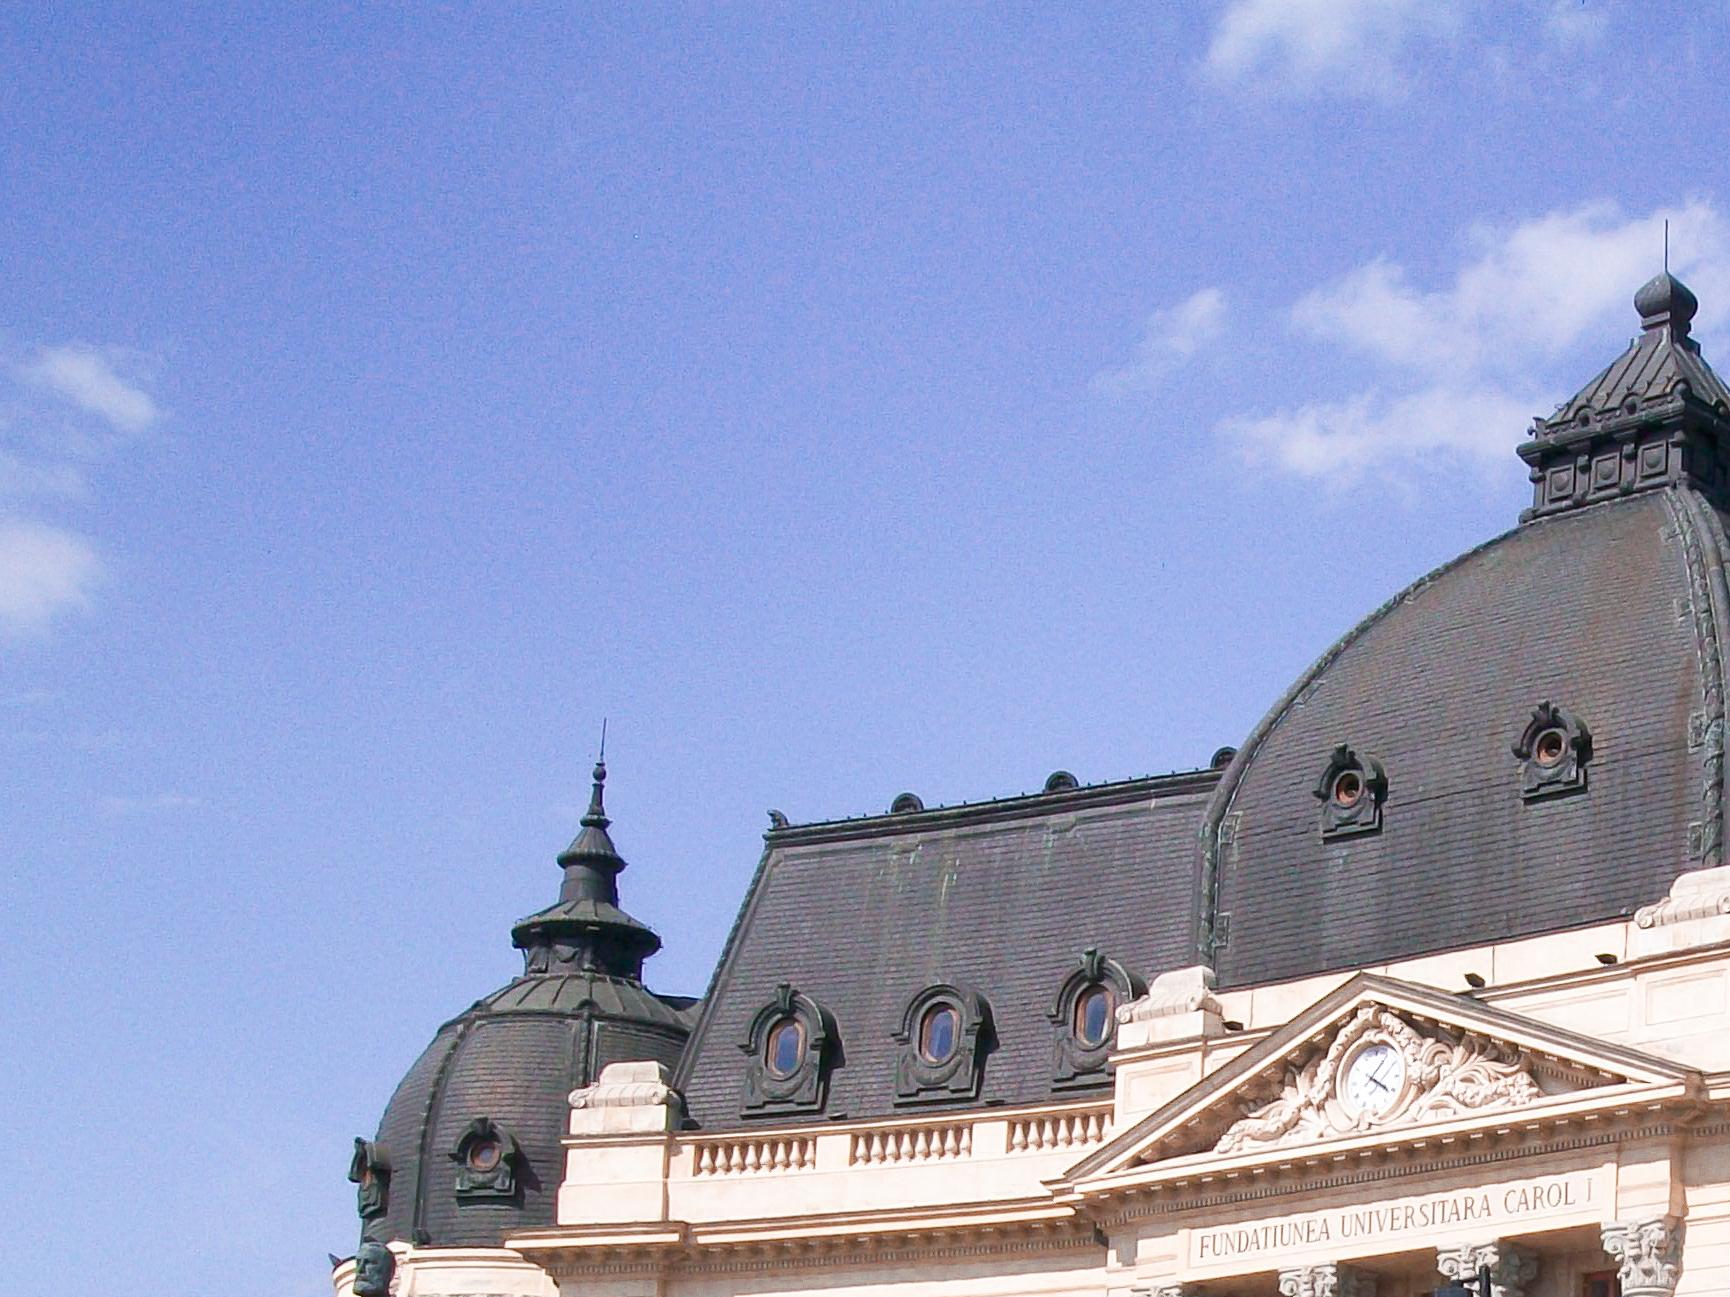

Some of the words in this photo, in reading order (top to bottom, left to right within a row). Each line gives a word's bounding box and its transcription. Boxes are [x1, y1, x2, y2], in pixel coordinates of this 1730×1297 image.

[1199, 1218, 1330, 1258] FUNDATIUNEA
[1340, 1194, 1492, 1238] UNIVERSITARA
[1503, 1181, 1576, 1215] CAROL
